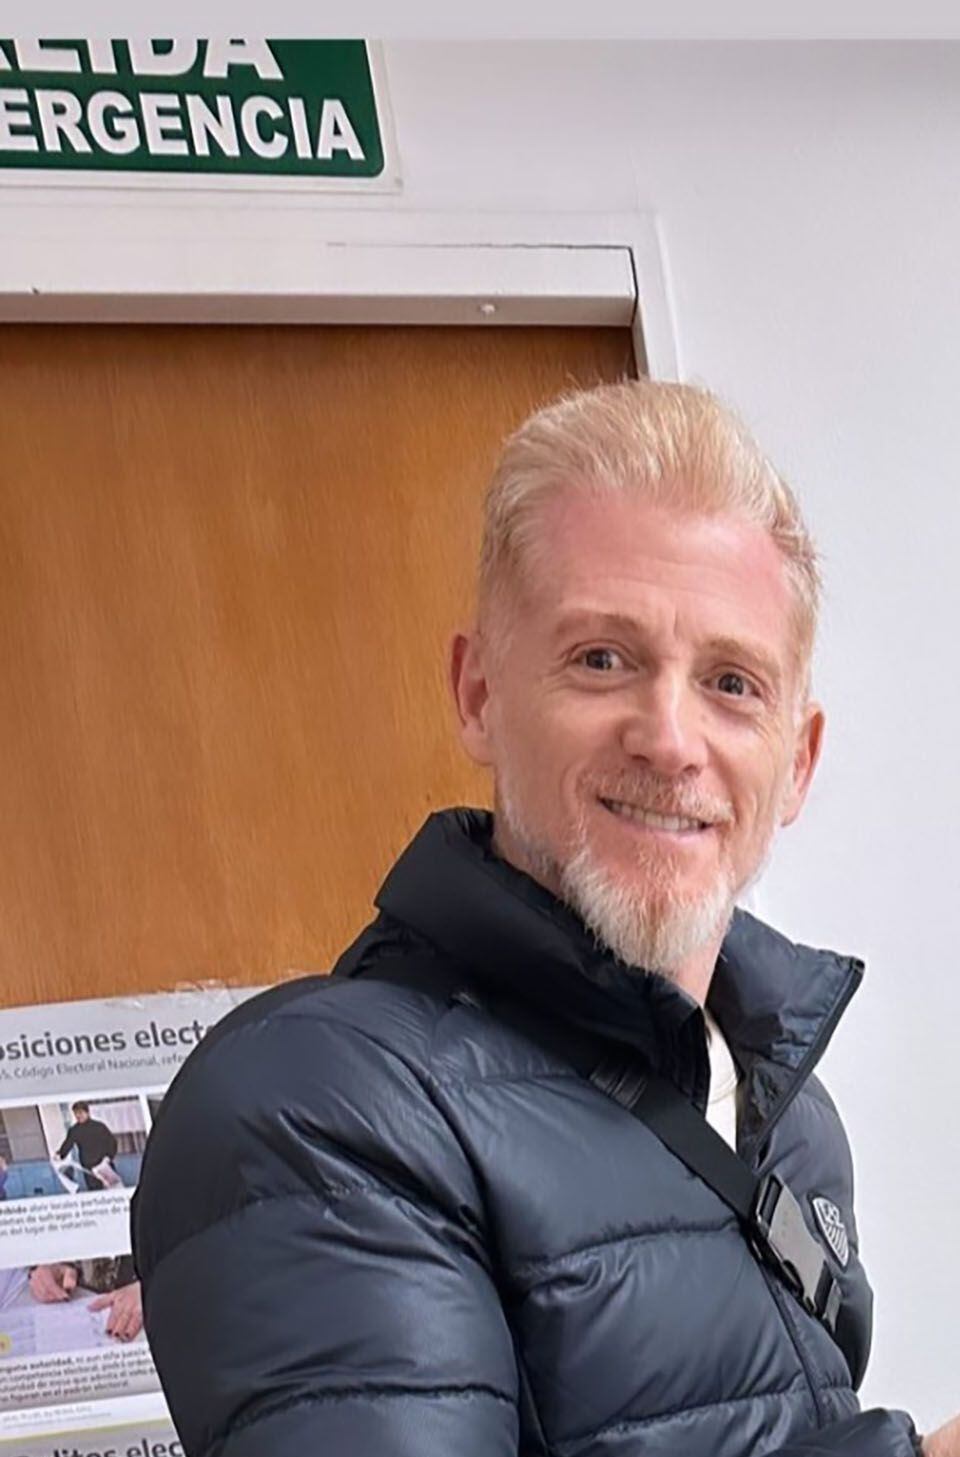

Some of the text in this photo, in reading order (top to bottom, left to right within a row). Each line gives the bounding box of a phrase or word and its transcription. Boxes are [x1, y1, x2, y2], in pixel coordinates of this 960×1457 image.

[0, 88, 366, 161] ERGENCIA
[135, 1020, 213, 1048] elect
[56, 1057, 105, 1075] Electoral
